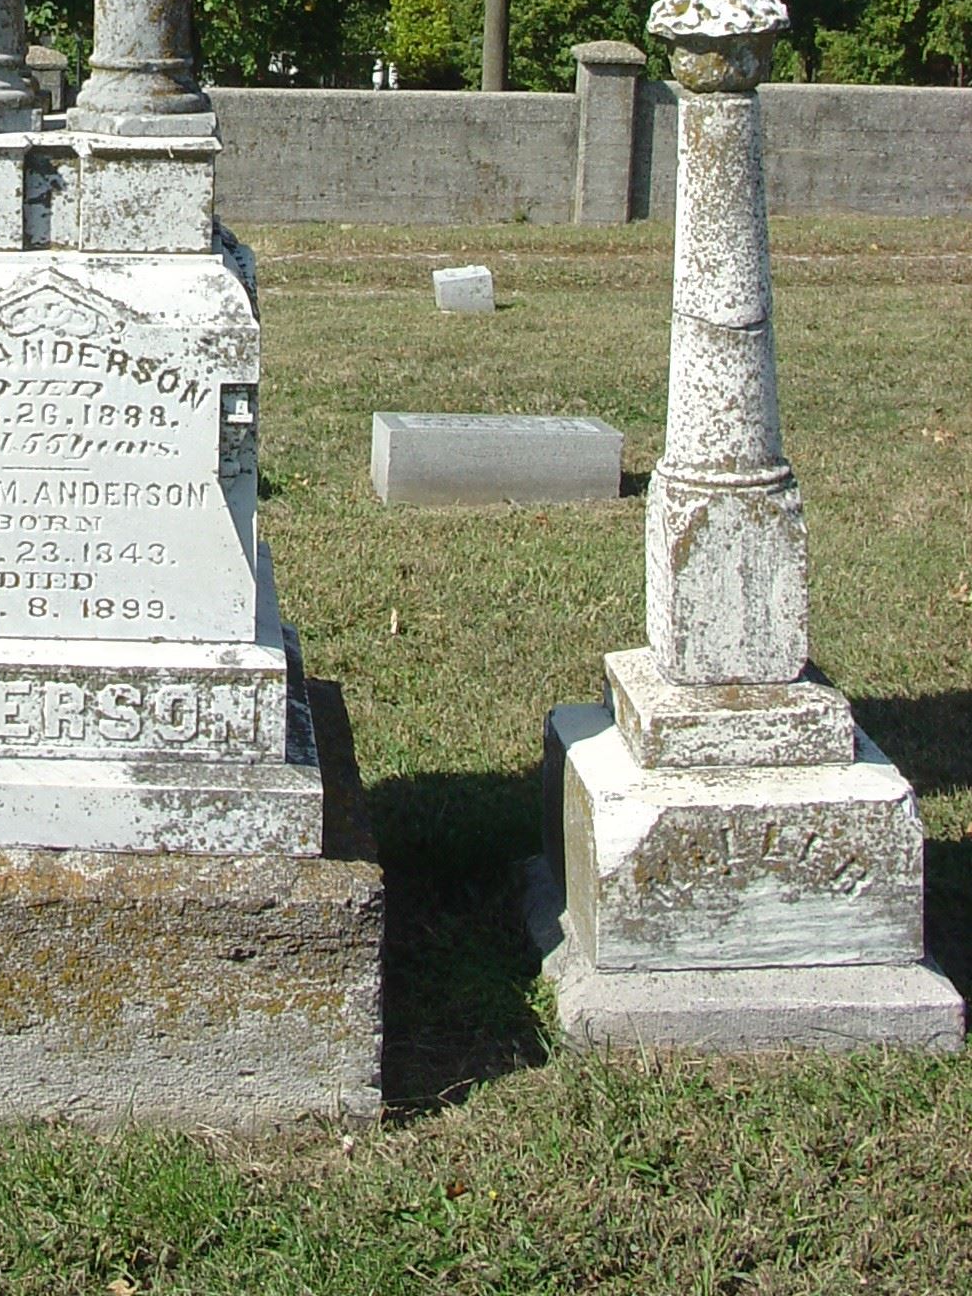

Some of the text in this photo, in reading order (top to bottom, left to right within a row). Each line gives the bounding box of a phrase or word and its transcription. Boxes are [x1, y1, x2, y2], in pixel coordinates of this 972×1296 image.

[25, 432, 68, 455] 55
[33, 480, 211, 507] ANDERSON
[83, 542, 177, 565] 1843.
[27, 596, 60, 619] 8.
[81, 597, 177, 621] 1899.
